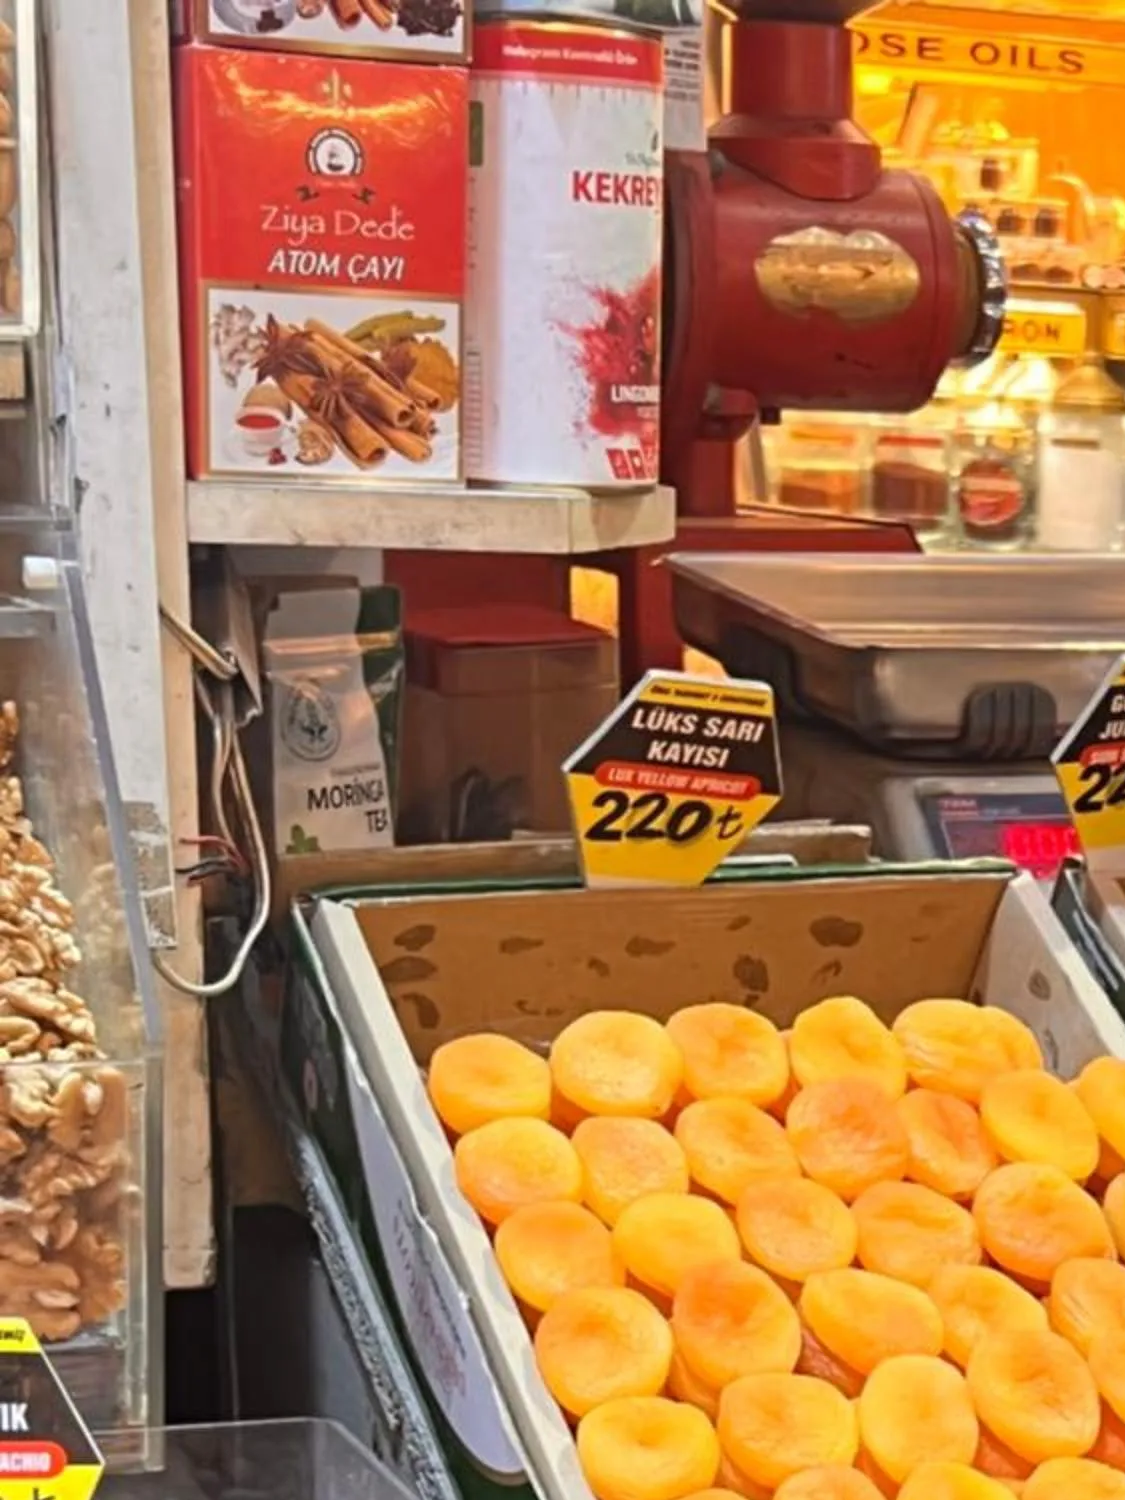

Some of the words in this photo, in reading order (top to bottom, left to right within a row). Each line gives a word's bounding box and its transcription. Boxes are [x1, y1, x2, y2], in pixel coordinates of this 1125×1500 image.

[969, 41, 1084, 74] OILS
[260, 204, 326, 246] Ziya
[334, 204, 415, 241] Dede
[267, 249, 341, 277] ATOM
[347, 253, 405, 284] ÇAYI
[631, 706, 699, 735] LÜKS
[702, 715, 765, 744] SARI
[647, 739, 730, 769] KAYISI
[0, 1402, 29, 1431] IK
